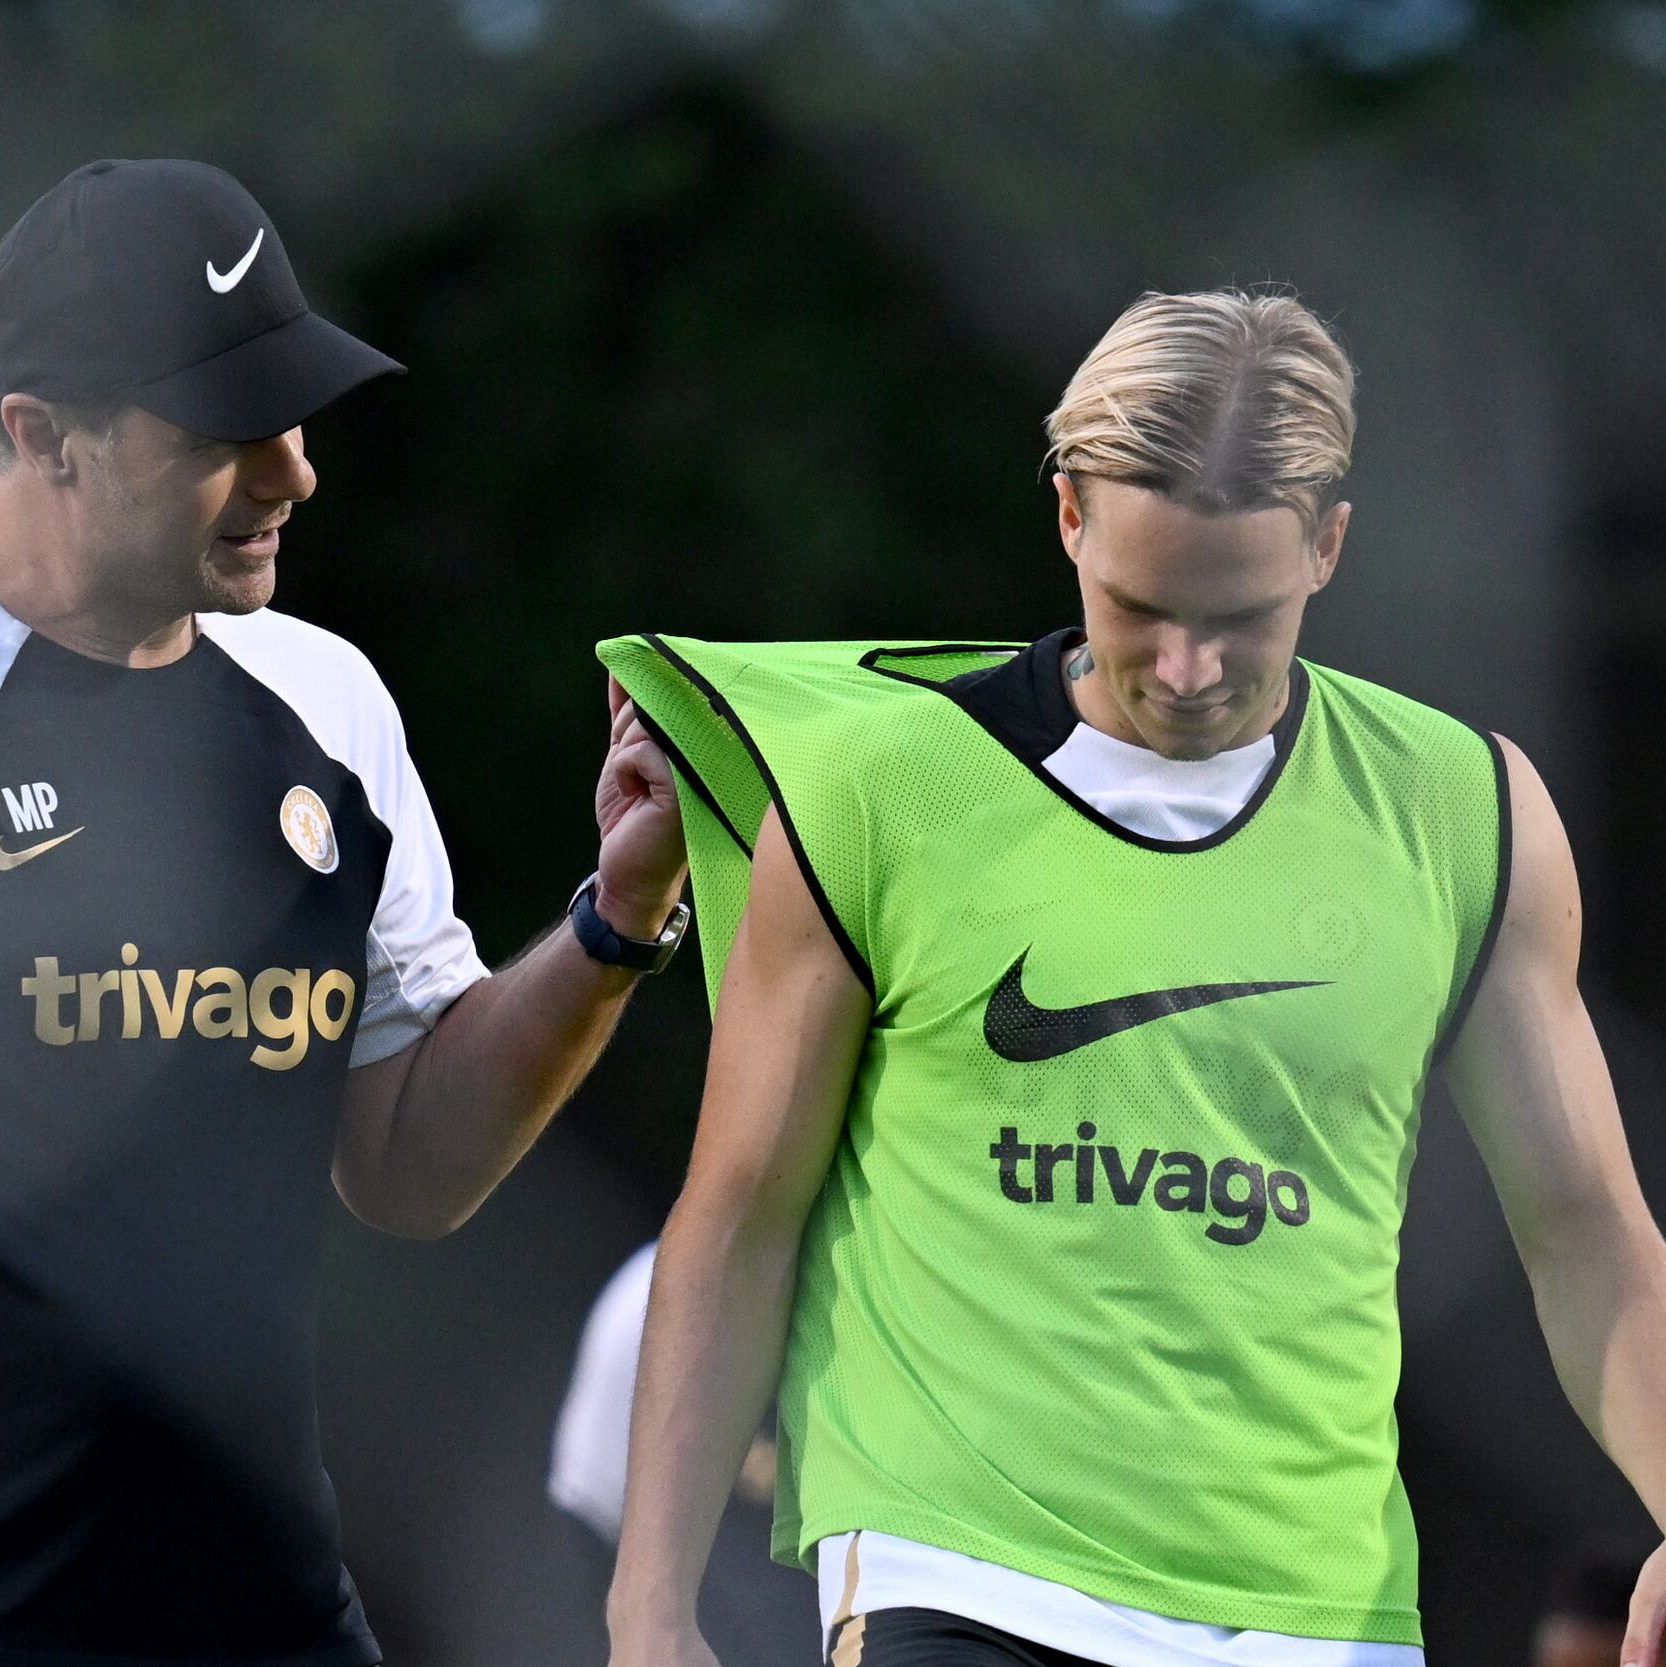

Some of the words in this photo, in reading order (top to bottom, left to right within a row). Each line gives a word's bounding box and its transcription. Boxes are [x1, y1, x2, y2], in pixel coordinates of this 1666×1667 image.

[1, 782, 58, 833] MP
[21, 943, 355, 1070] trivago
[989, 1121, 1310, 1245] trivago
